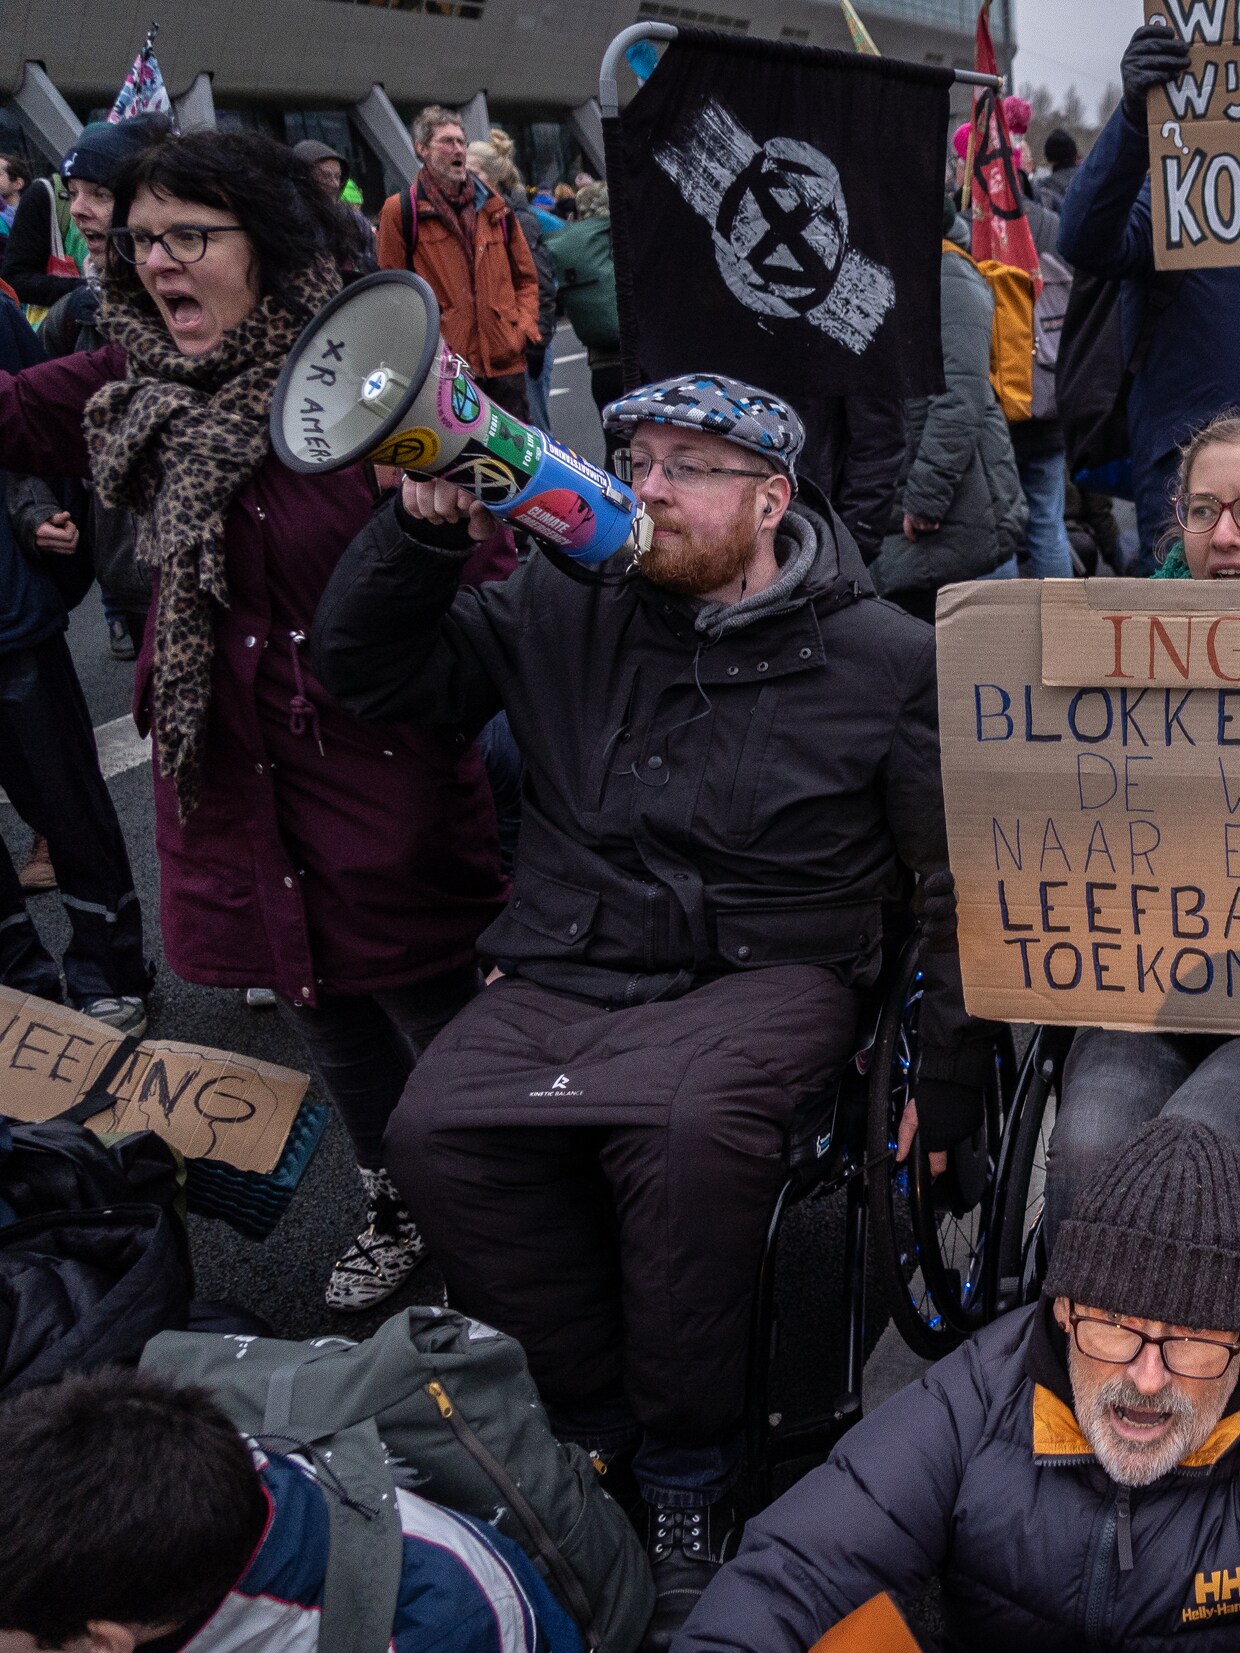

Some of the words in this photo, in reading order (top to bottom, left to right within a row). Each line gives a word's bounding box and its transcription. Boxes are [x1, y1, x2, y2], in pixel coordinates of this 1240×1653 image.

[306, 339, 345, 386] XR
[488, 413, 498, 437] REBEL
[522, 449, 533, 467] FOR
[520, 513, 573, 545] EMERGENCY
[527, 506, 570, 533] CLIMATE
[1077, 752, 1155, 813] DE
[992, 817, 1161, 876] NAAR
